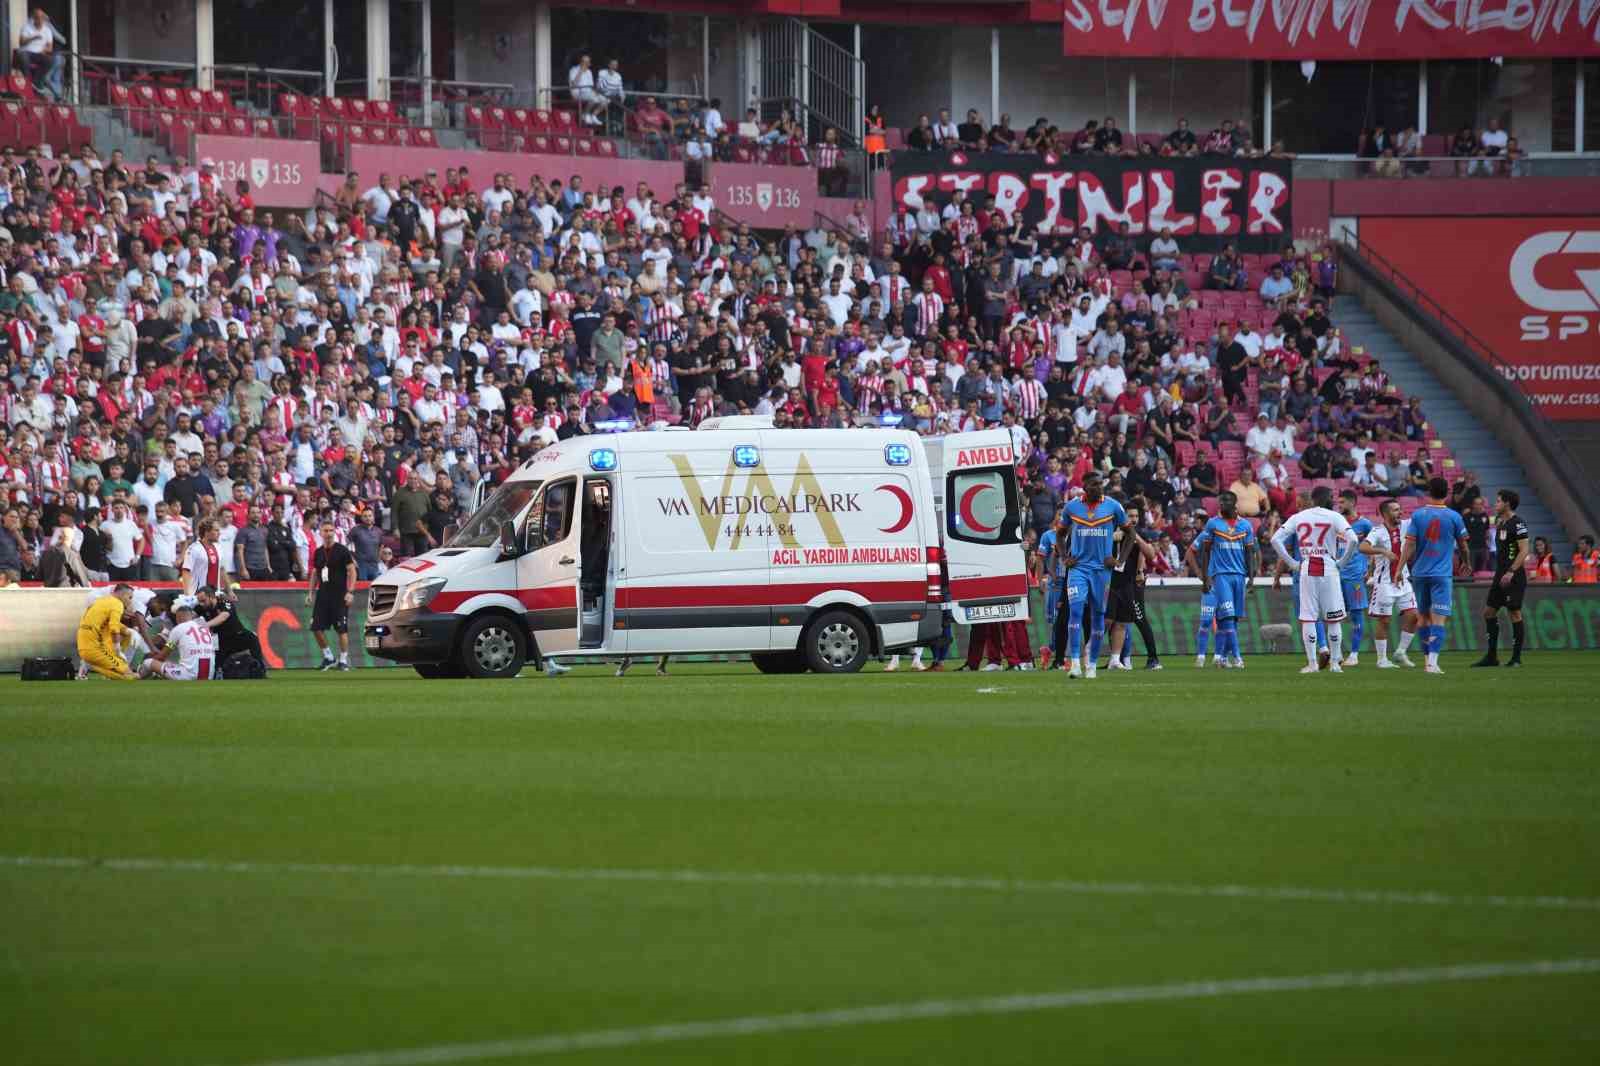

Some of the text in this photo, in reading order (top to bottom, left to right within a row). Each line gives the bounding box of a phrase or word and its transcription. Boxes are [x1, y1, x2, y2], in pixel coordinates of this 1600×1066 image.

[217, 160, 246, 181] 134
[272, 163, 301, 185] 135
[727, 185, 753, 206] 135
[776, 187, 801, 209] 136
[1520, 315, 1600, 341] SP
[957, 446, 1013, 467] AMBU
[700, 492, 863, 516] MEDICALPARK
[724, 523, 796, 537] 444 44 84
[1296, 522, 1332, 547] 27
[1424, 519, 1441, 545] 4
[803, 548, 849, 564] YARDIM
[851, 547, 921, 563] AMBULANSI
[186, 624, 212, 645] 18
